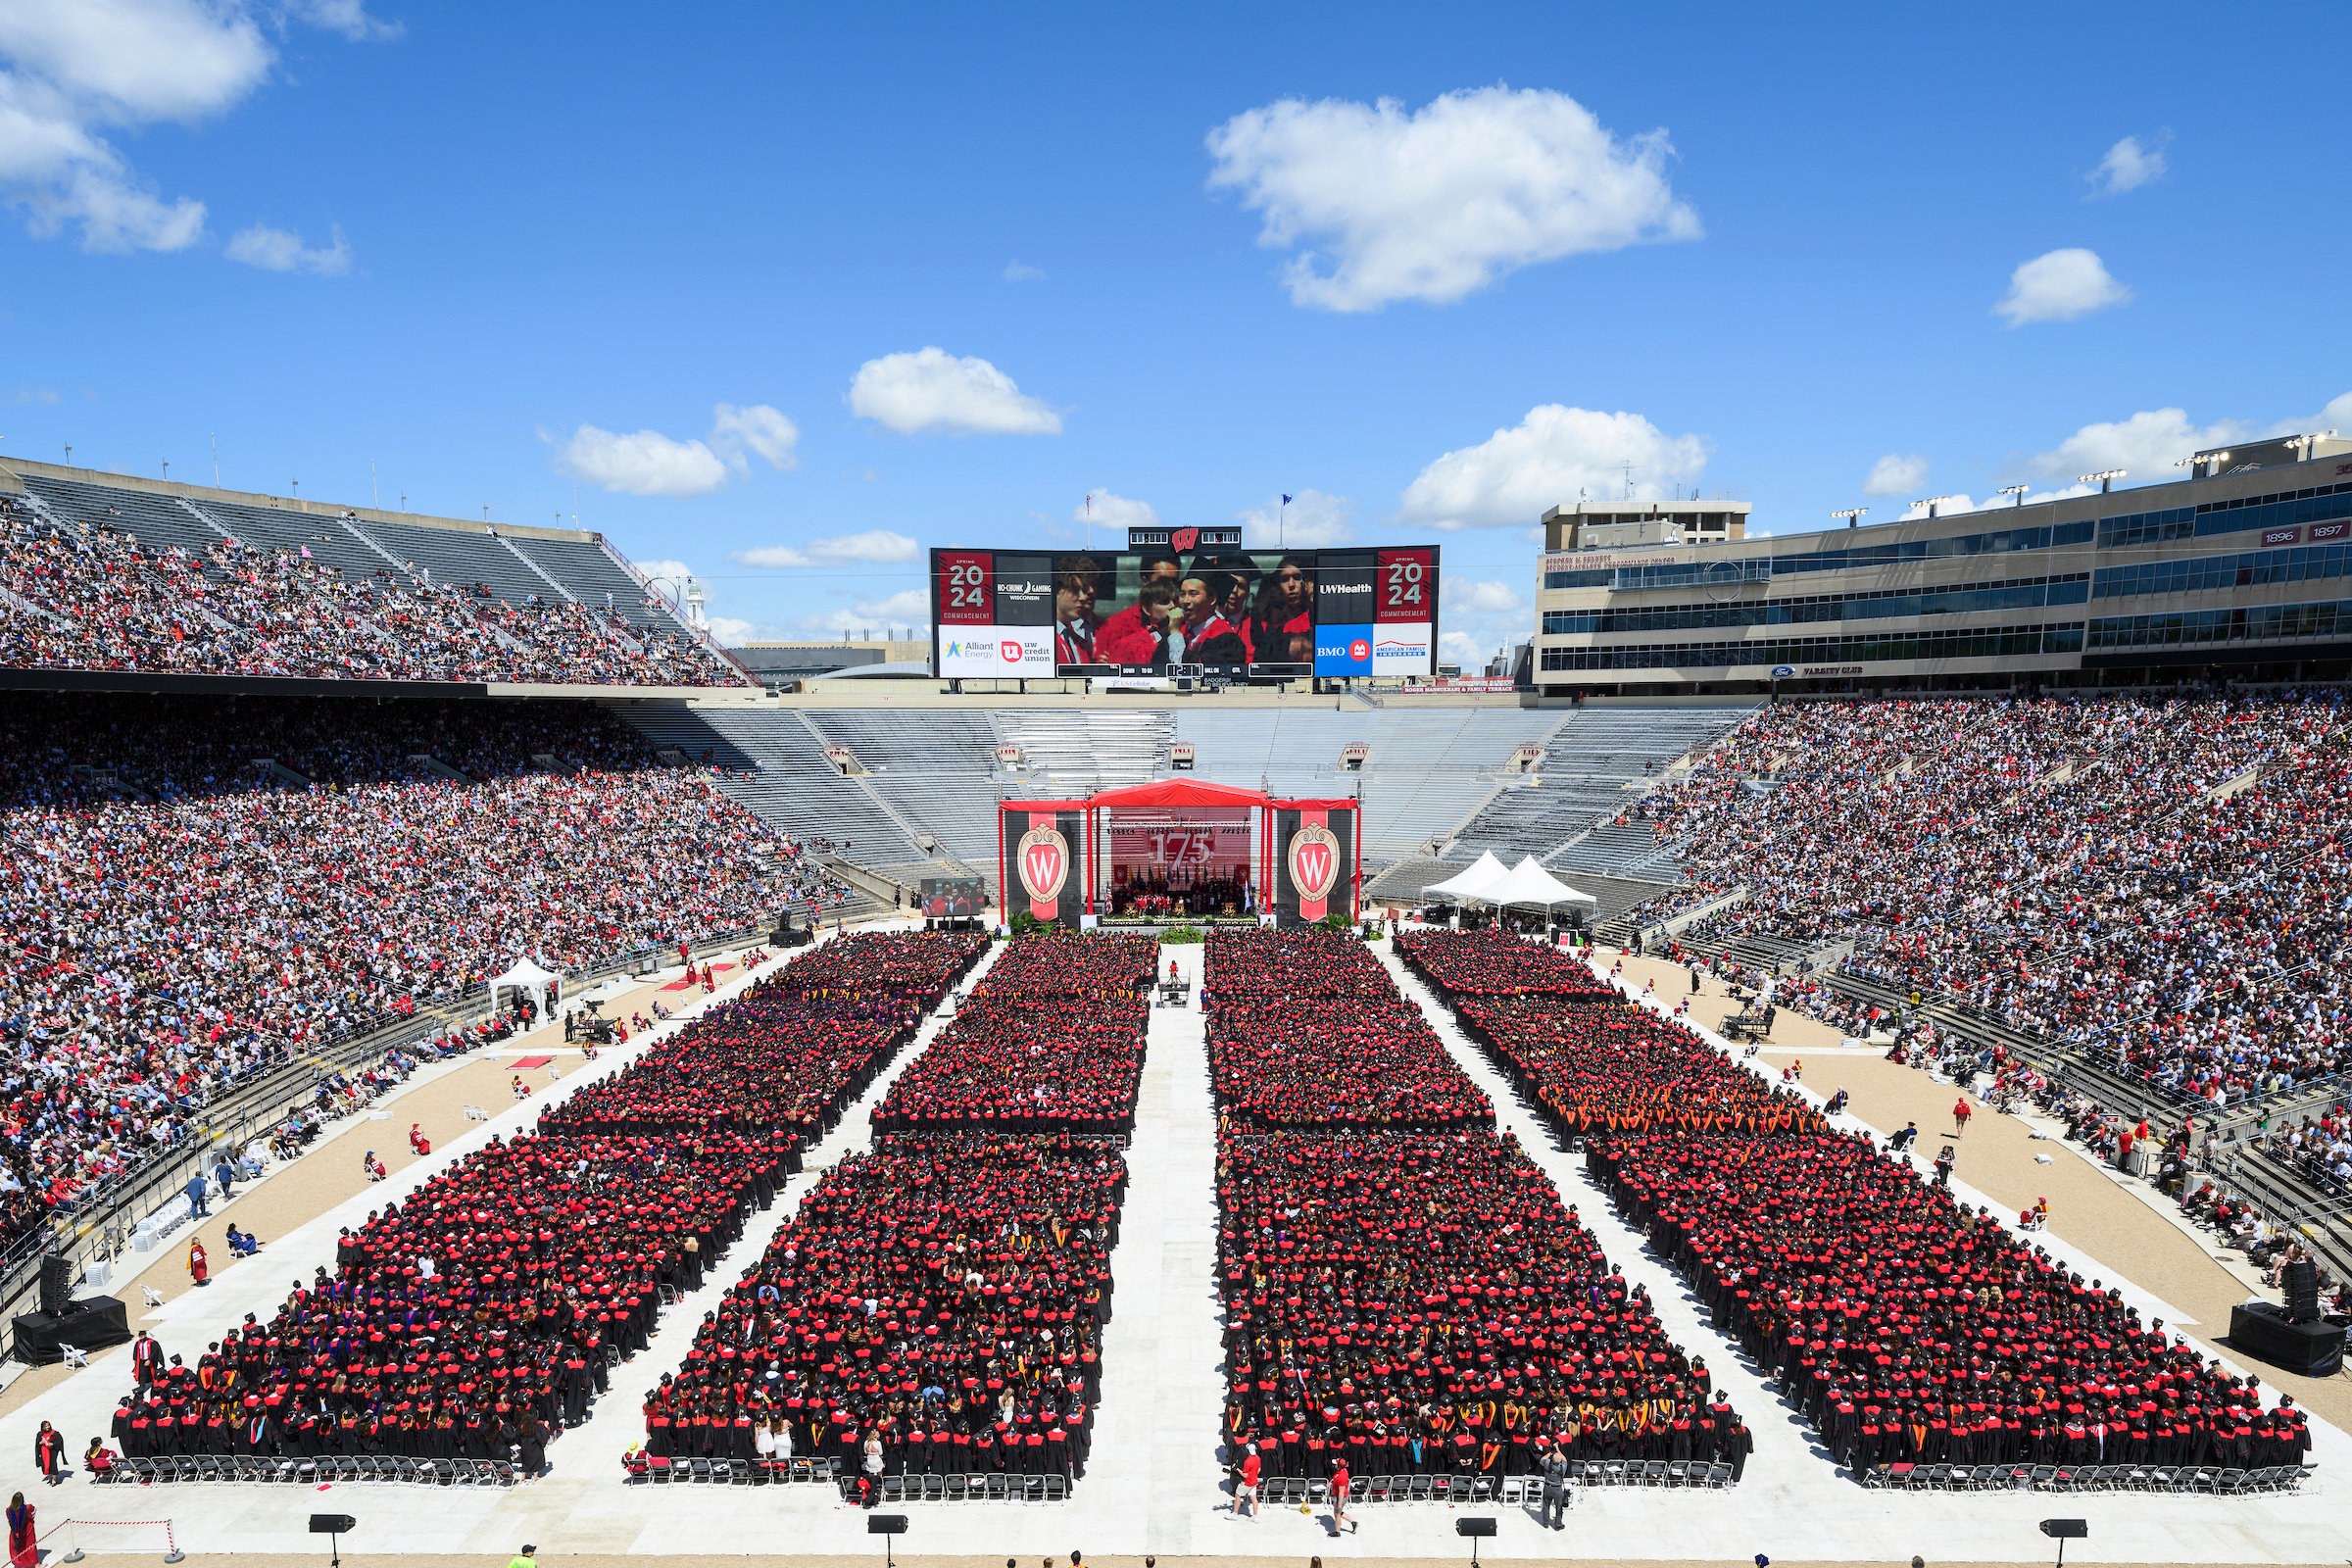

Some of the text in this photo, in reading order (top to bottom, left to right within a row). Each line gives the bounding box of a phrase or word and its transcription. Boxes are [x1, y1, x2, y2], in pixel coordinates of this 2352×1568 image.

[1172, 528, 1199, 554] W
[2266, 531, 2293, 543] 1896
[2314, 525, 2343, 537] 1897
[950, 565, 983, 586] 20
[1389, 563, 1422, 583] 20
[951, 587, 984, 607] 24
[997, 584, 1051, 592] HO-CHUNK GAMING
[1388, 584, 1421, 605] 24
[965, 642, 994, 650] Alliant
[1317, 647, 1346, 656] BMO
[1151, 833, 1209, 875] 175
[1029, 851, 1056, 888] W
[1300, 850, 1327, 886] W
